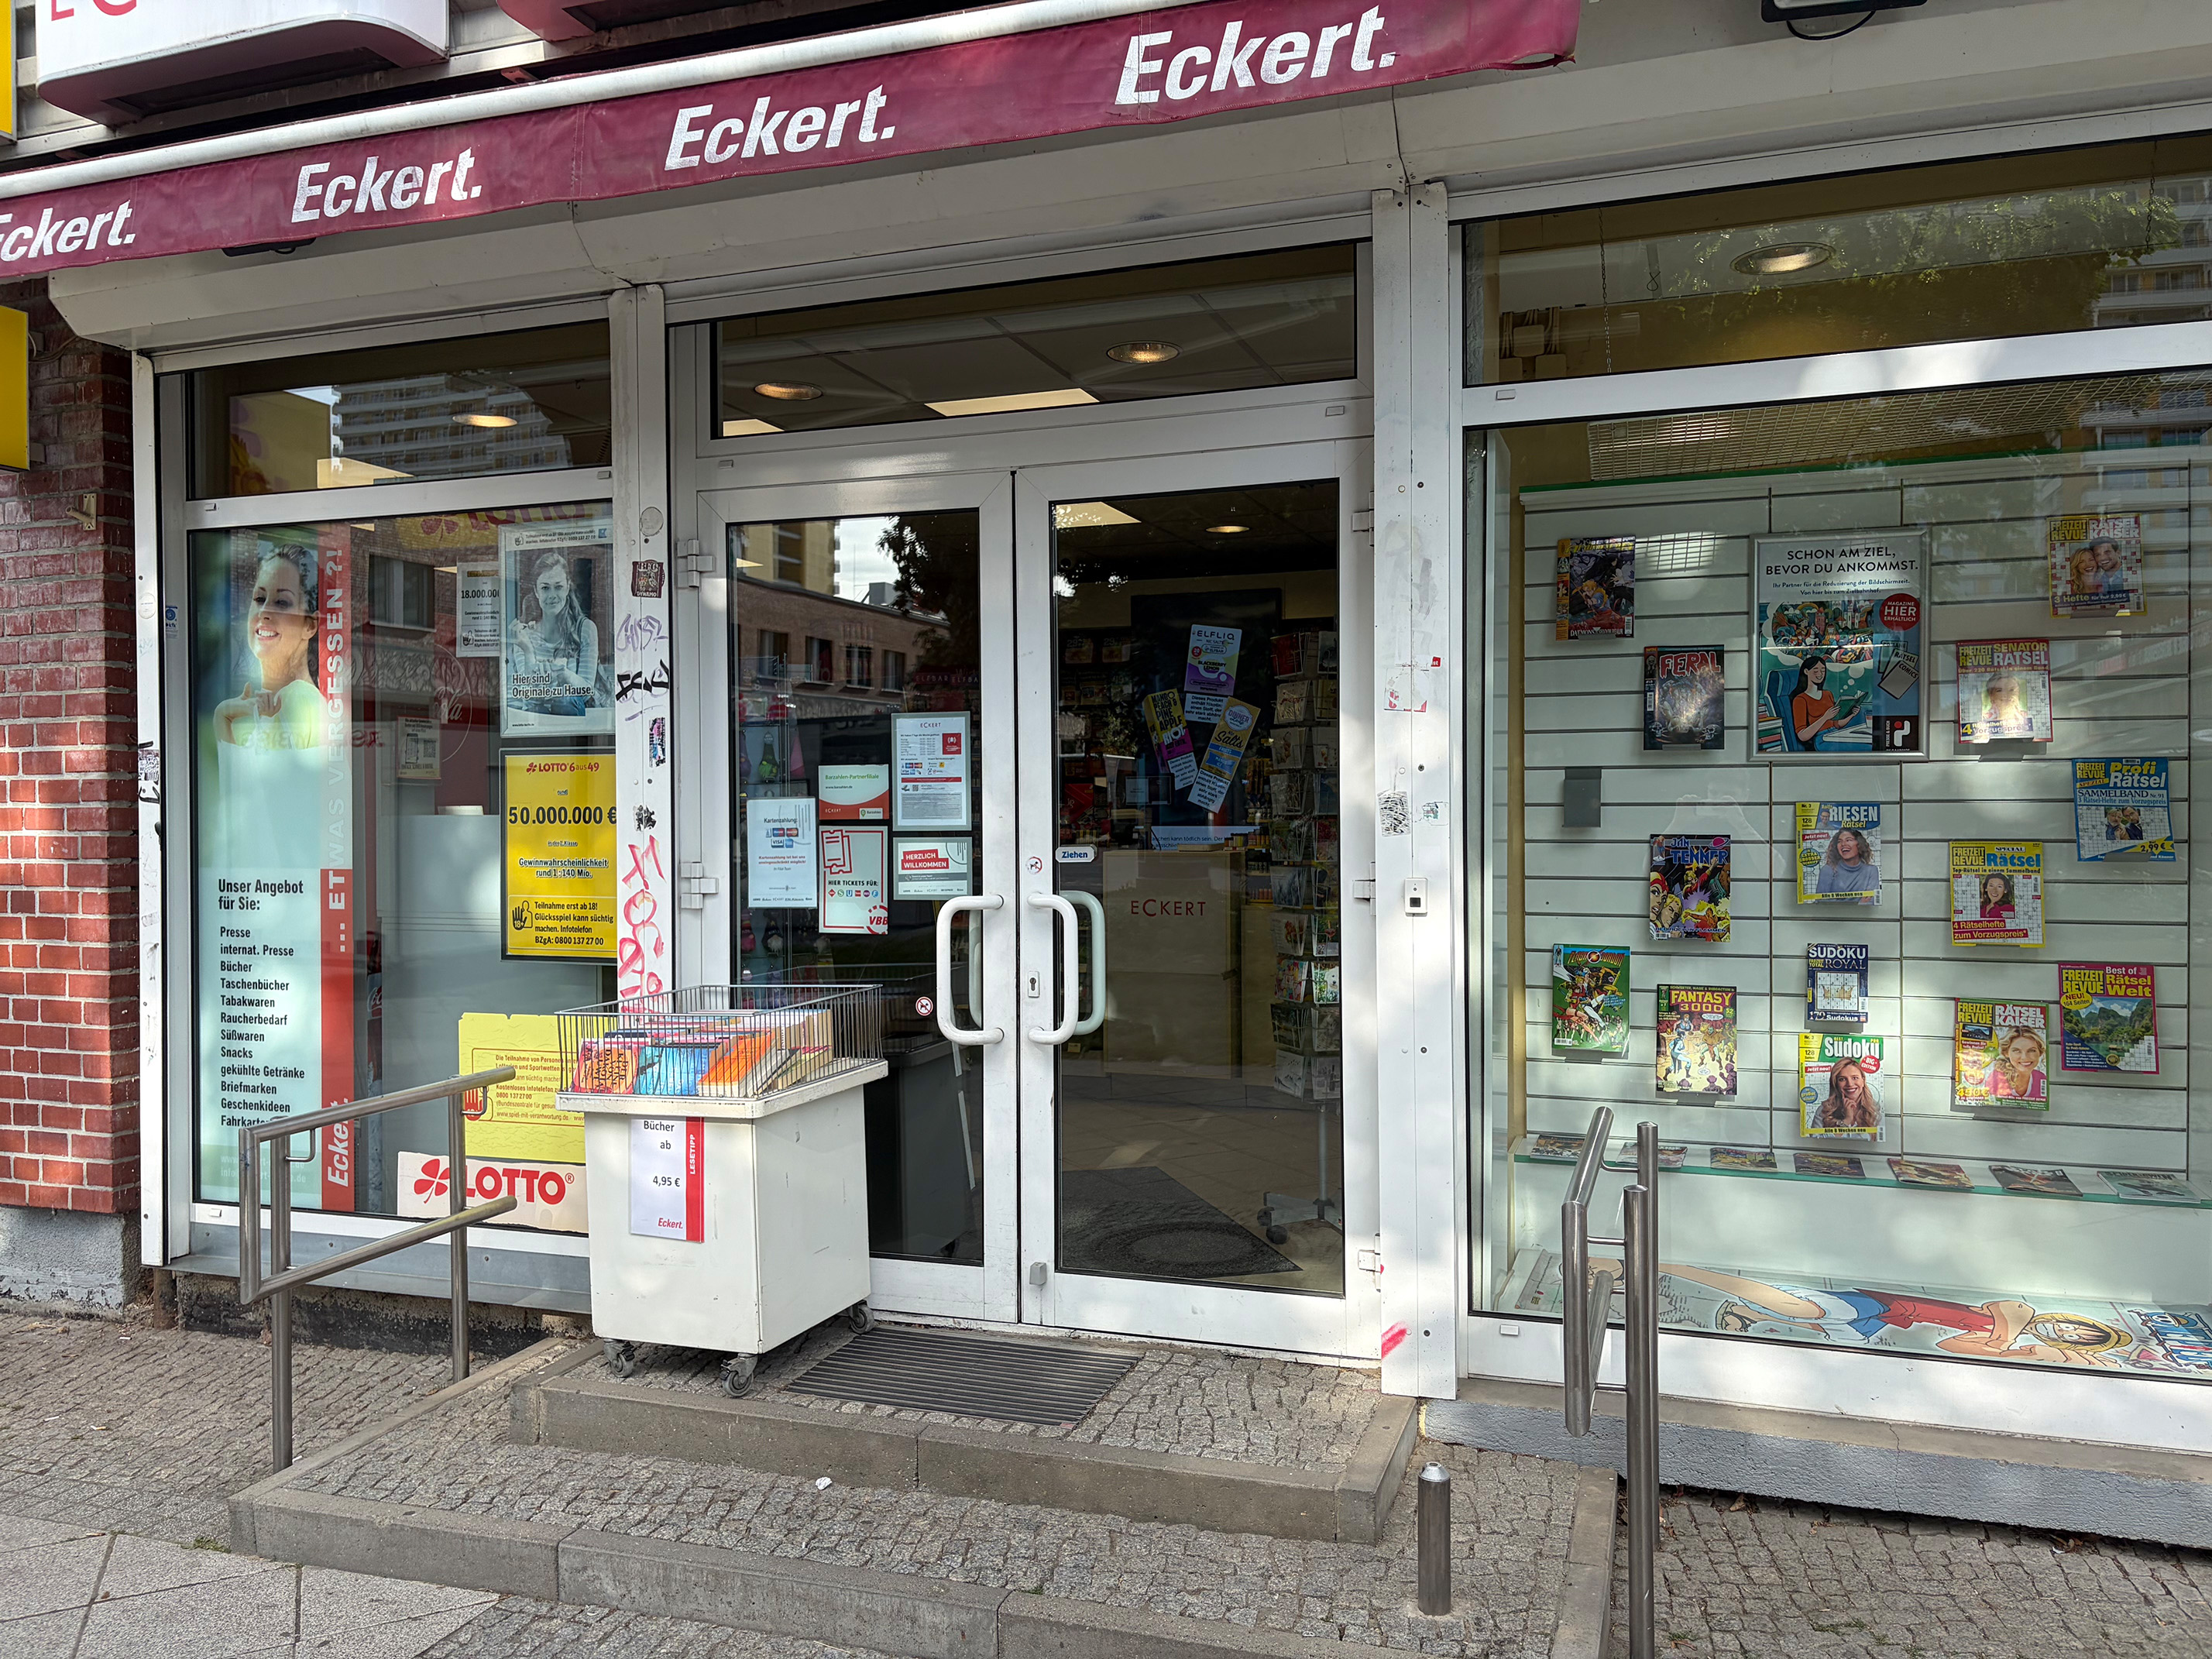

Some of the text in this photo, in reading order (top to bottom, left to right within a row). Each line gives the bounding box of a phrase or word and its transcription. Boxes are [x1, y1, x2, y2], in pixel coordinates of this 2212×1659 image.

[1115, 4, 1396, 105] Eckert.
[665, 84, 895, 170] Eckert.
[291, 146, 483, 223] Eckert.
[2051, 520, 2087, 531] FREIZEIT
[2051, 530, 2087, 541] REVUE
[2090, 528, 2139, 539] KAISER
[1788, 546, 1896, 560] SCHON AM ZIEL,
[1766, 560, 1918, 575] BEVOR DU ANKOMMST.
[1884, 606, 1917, 617] HIER
[1197, 630, 1235, 641] ELFLIQ
[1960, 645, 1992, 656] FREIZEIT
[1994, 642, 2047, 652] SENATOR
[1894, 651, 1917, 664] RÄTSEL
[1960, 655, 1992, 666] REVUE
[1660, 652, 1721, 678] FERAL
[1898, 662, 1918, 678] COMICS
[512, 672, 550, 685] Hier sind
[326, 589, 345, 788] VERGESSEN
[512, 685, 594, 698] Originale zu Hause.
[1156, 708, 1173, 720] PINE
[1159, 716, 1183, 731] APPLE
[1214, 730, 1243, 748] Salts
[2076, 770, 2105, 778] REVUE
[2110, 761, 2156, 774] Profi
[2109, 772, 2166, 788] Rätsel
[509, 806, 617, 825] 50.000.000 €
[1829, 806, 1877, 821] RIESEN
[1671, 836, 1690, 848] JAN
[328, 797, 346, 910] ETWAS
[1062, 850, 1088, 859] Ziehen
[1670, 846, 1728, 864] TENNER
[1953, 847, 1984, 857] FREIZEIT
[519, 858, 608, 867] Gewinnwahrscheinlichkeit
[1953, 857, 1984, 865] REVUE
[1987, 854, 2041, 867] Rätsel
[218, 879, 304, 896] Unser Angebot
[218, 896, 260, 910] für Sie:
[534, 902, 565, 910] Teilnahme
[589, 902, 598, 911] 18!
[1131, 898, 1206, 917] ECKERT
[535, 913, 571, 922] Glücksspiel
[590, 915, 613, 924] süchtig
[869, 916, 888, 925] VBB
[221, 926, 250, 937] Presse
[535, 936, 553, 945] BZgA:
[221, 944, 294, 956] internat. Presse
[1808, 946, 1866, 959] SUDOKU
[221, 960, 252, 972] Bücher
[1826, 959, 1866, 969] ROYAL
[2063, 970, 2104, 981] FREIZEIT
[2107, 975, 2151, 985] Rätsel
[221, 977, 289, 991] Taschenbücher
[2063, 981, 2104, 994] REVUE
[2107, 984, 2152, 997] Welt
[221, 994, 275, 1008] Tabakwaren
[1671, 991, 1733, 1005] FANTASY
[1681, 1003, 1723, 1012] 3000
[1958, 1002, 1993, 1013] FREIZEIT
[1995, 1005, 2043, 1018] RÄTSEL
[221, 1012, 287, 1025] Raucherbedarf
[1958, 1012, 1992, 1024] REVUE
[1995, 1016, 2045, 1028] KAISER
[221, 1029, 264, 1042] Süßwaren
[221, 1046, 253, 1058] Snacks
[1825, 1037, 1879, 1059] Sudoku
[221, 1065, 304, 1078] gekühlte Getränke
[221, 1081, 276, 1094] Briefmarken
[222, 1098, 290, 1112] Geschenkideen
[644, 1120, 675, 1132] Bücher
[660, 1140, 672, 1149] ab
[653, 1176, 681, 1187] 4,95 €
[658, 1218, 683, 1229] Eckert.
